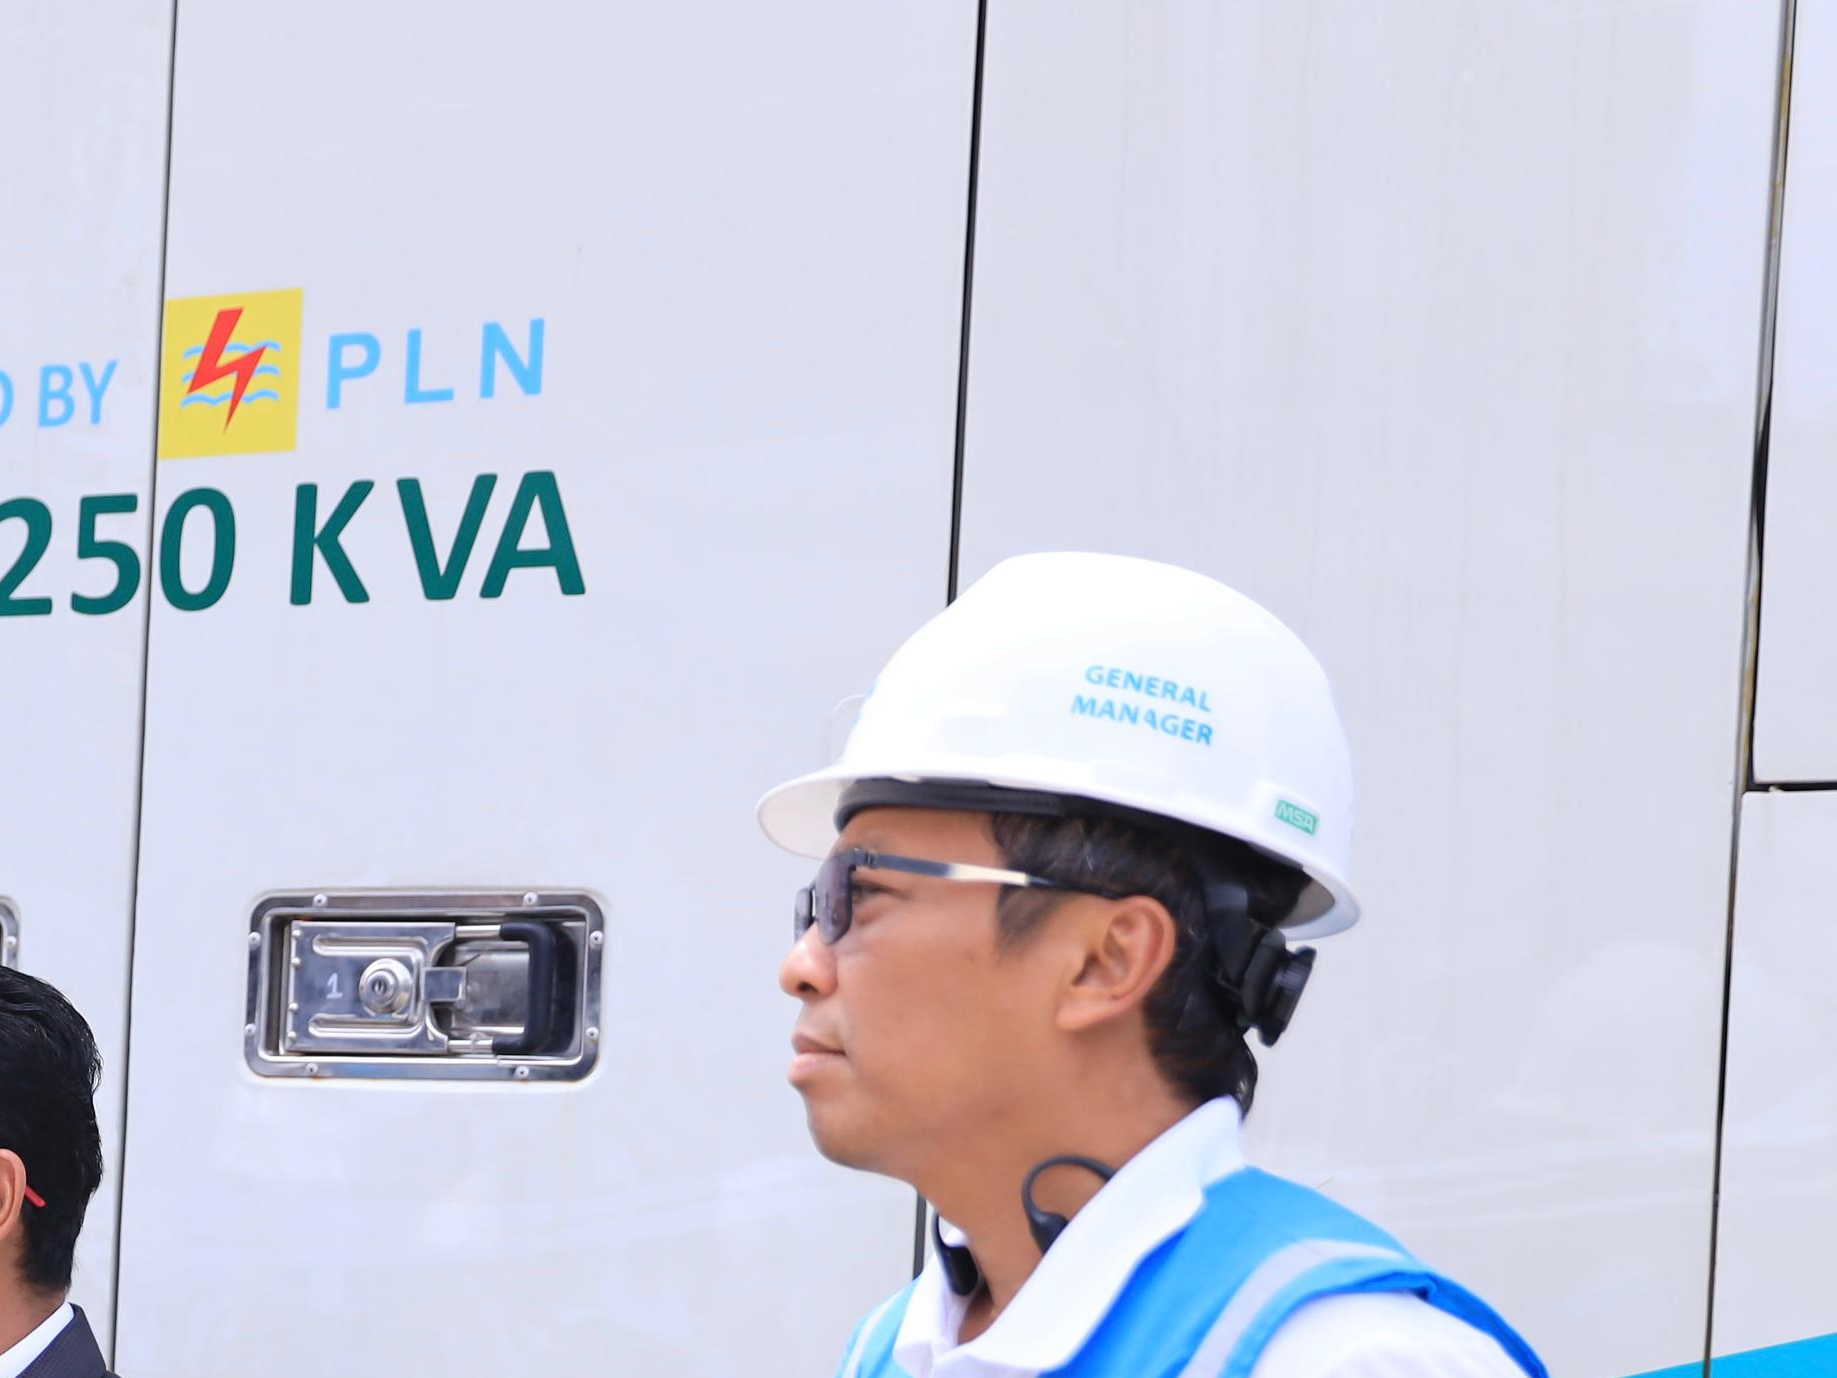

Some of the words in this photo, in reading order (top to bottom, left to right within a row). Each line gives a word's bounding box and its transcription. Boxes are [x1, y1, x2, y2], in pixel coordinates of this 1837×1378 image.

[325, 316, 547, 411] PLN
[37, 359, 119, 431] BY
[1084, 664, 1213, 713] GENERAL
[1070, 694, 1214, 746] MANAGER
[1276, 801, 1315, 834] MSA
[326, 971, 344, 999] 1
